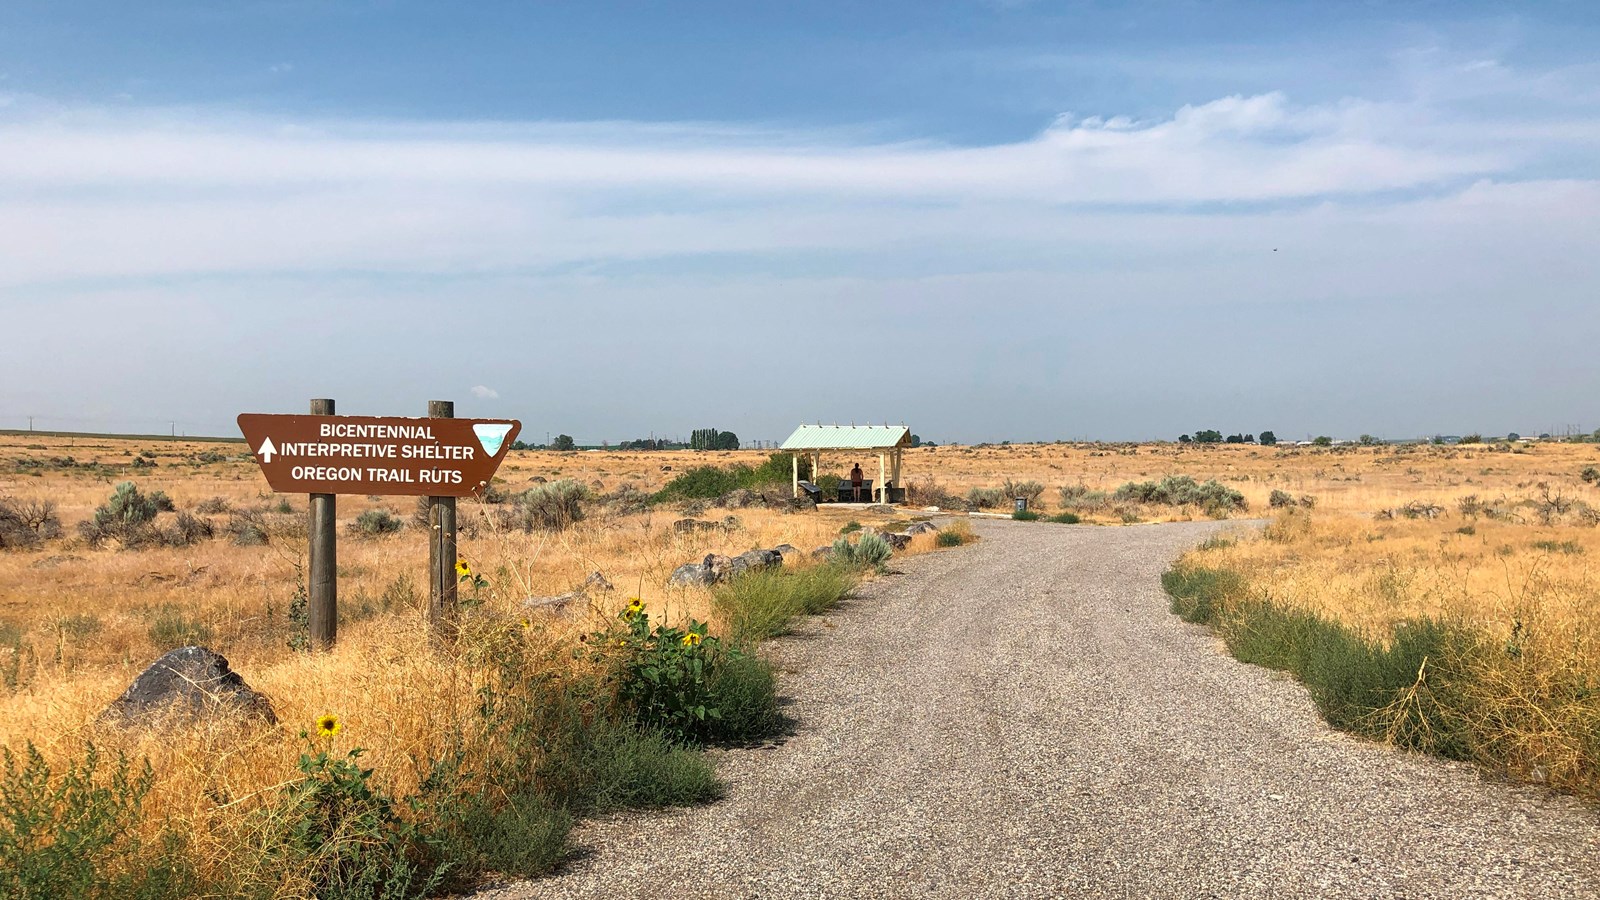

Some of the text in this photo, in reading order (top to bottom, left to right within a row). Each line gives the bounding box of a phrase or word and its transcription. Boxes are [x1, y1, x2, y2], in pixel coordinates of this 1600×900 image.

[320, 424, 436, 439] BICENTENNIAL
[281, 443, 474, 460] INTERPRETIVE SHELTER
[291, 466, 463, 484] OREGON TRAIL RUTS
